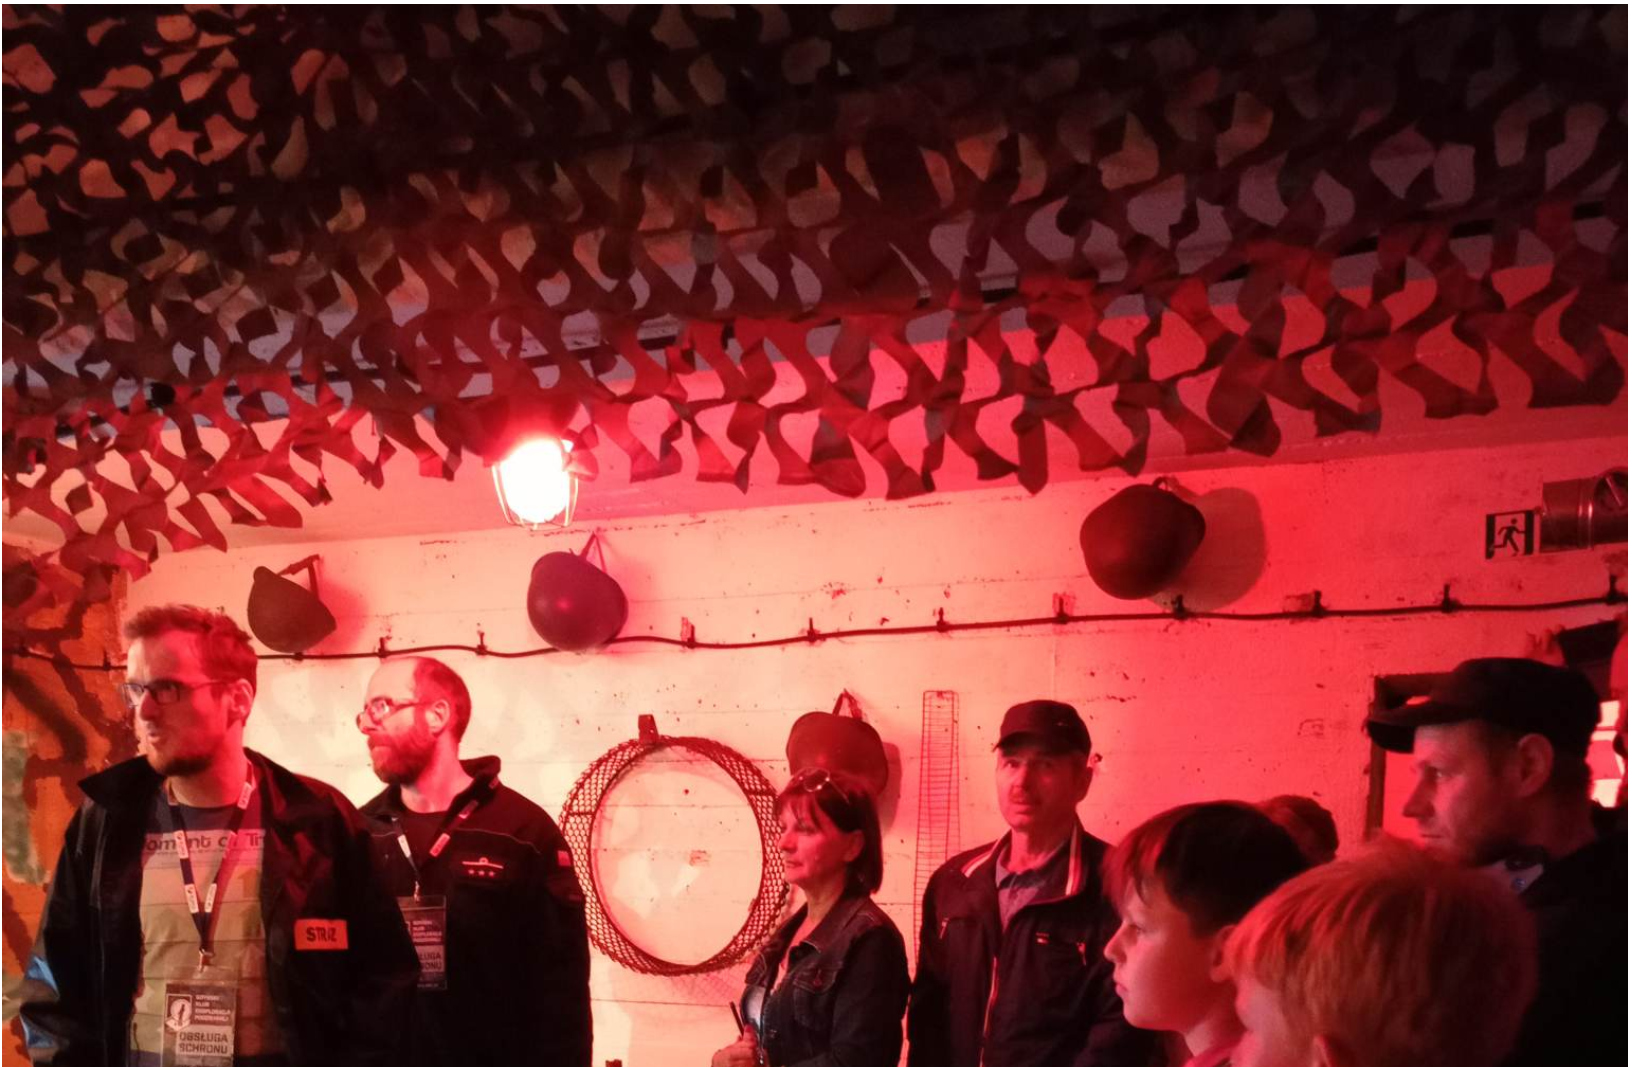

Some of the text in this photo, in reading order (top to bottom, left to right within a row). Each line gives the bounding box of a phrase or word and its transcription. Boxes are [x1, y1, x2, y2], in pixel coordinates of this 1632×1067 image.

[147, 835, 211, 851] omnt
[179, 1032, 228, 1042] OBSŁUGA
[179, 1043, 228, 1054] SCHRONU
